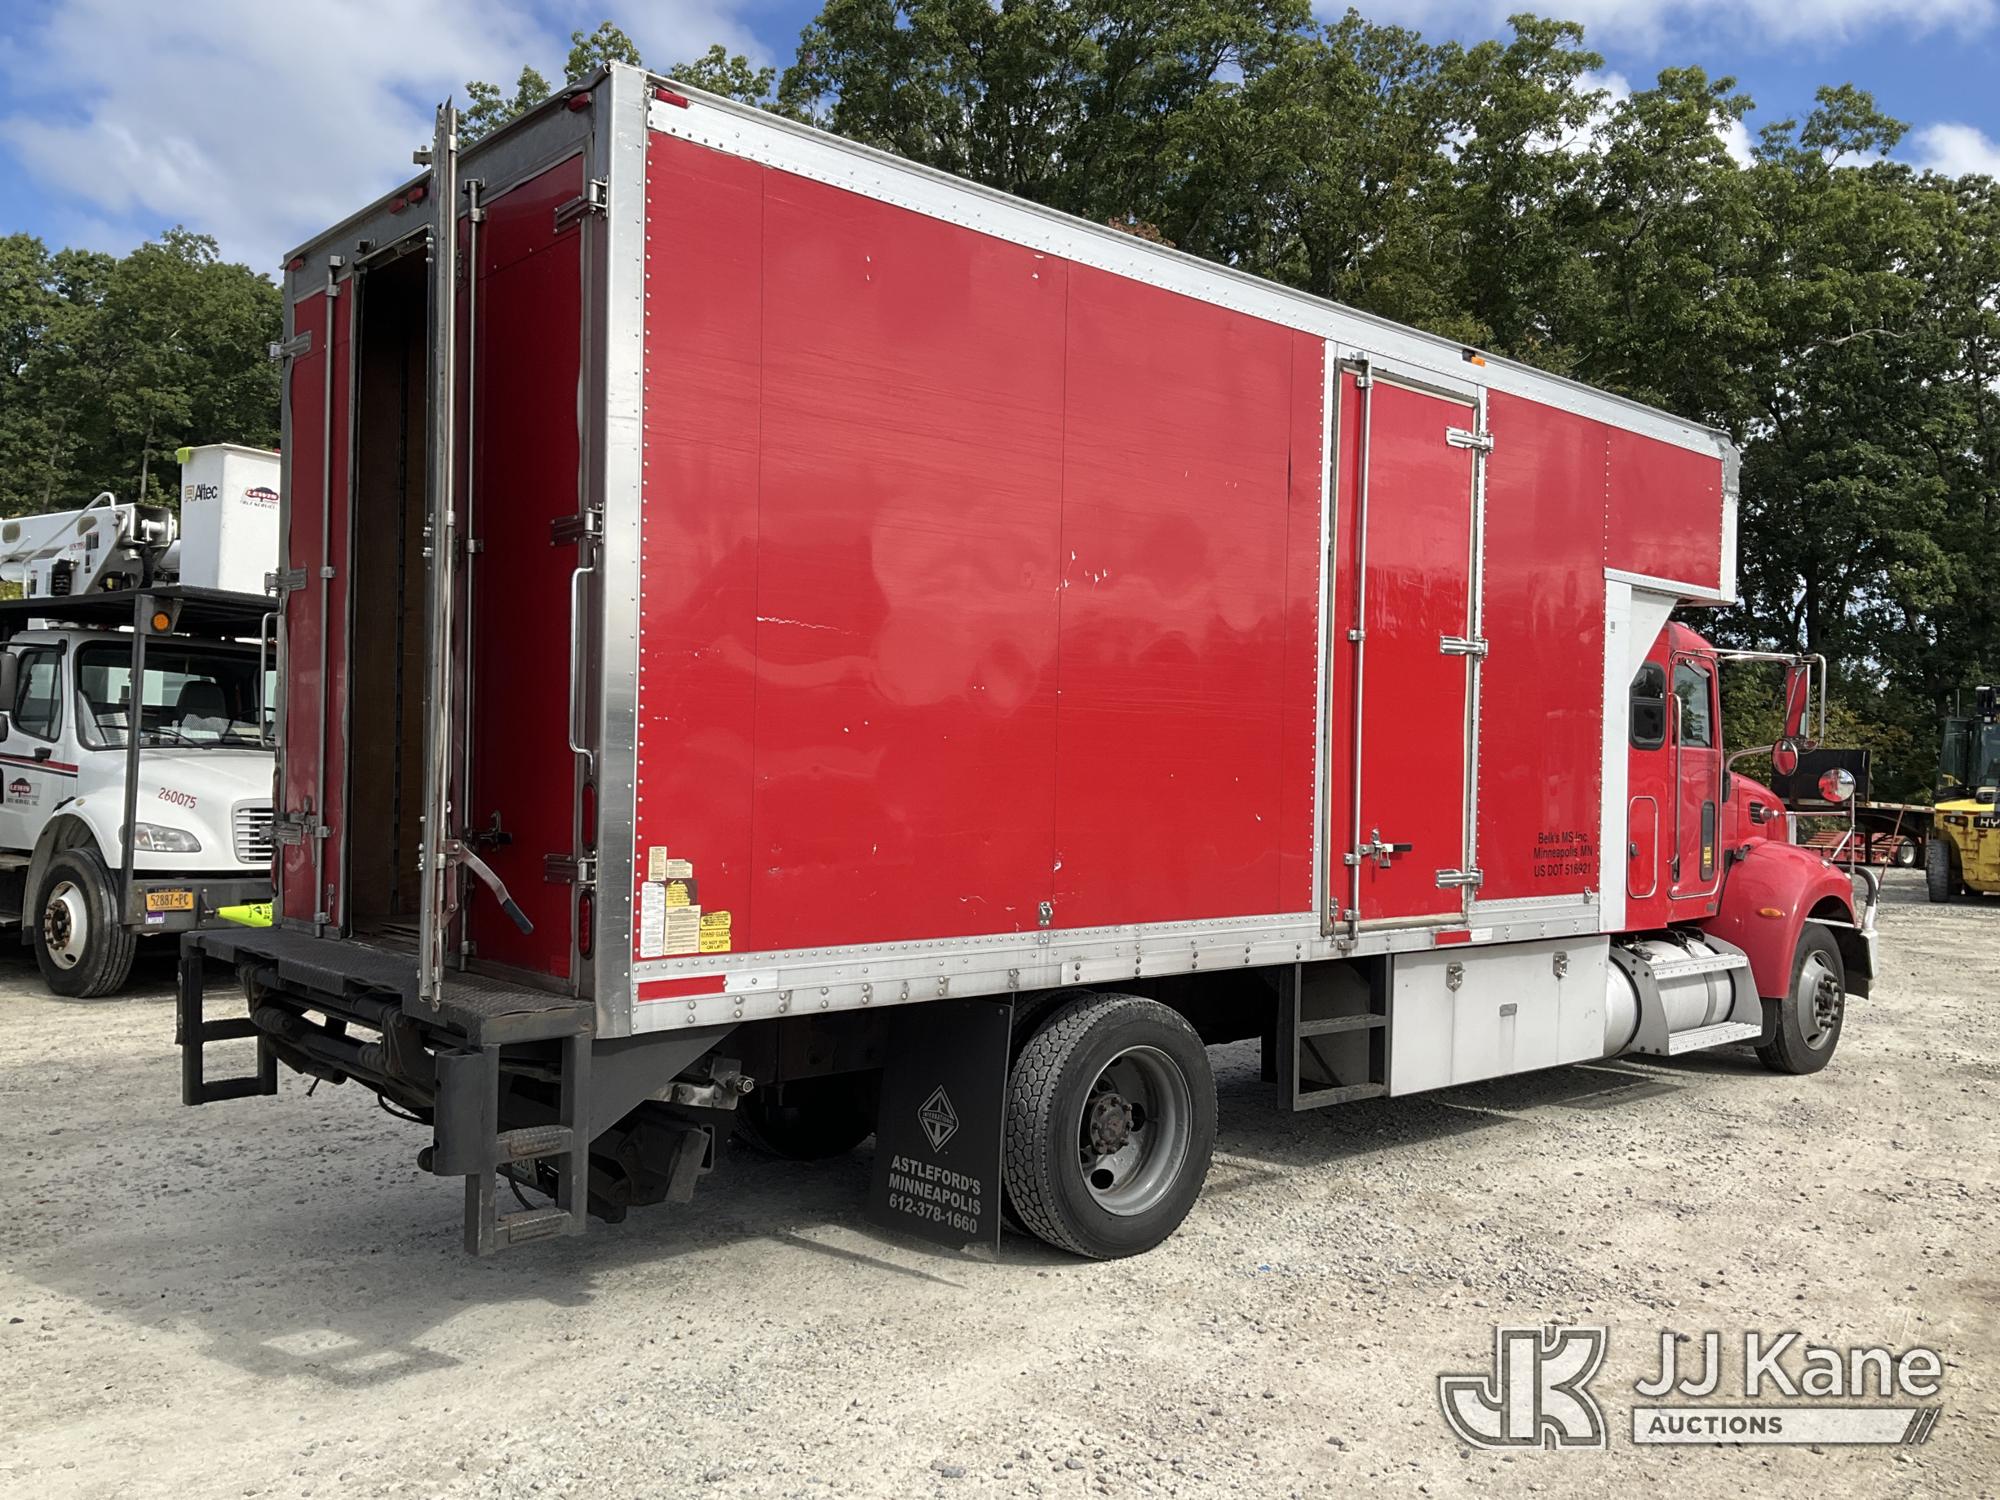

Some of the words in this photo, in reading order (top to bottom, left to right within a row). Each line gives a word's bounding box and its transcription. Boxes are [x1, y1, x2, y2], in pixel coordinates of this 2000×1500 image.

[195, 484, 218, 501] Altec
[158, 787, 197, 809] 260075
[1561, 831, 1574, 843] MS
[1580, 845, 1593, 856] MN
[1534, 864, 1546, 877] US
[1547, 863, 1564, 876] DOT
[891, 1154, 981, 1195] ASTLEFORD'S
[888, 1173, 981, 1215] MINNEAPOLIS
[889, 1193, 978, 1234] 612-378-1660
